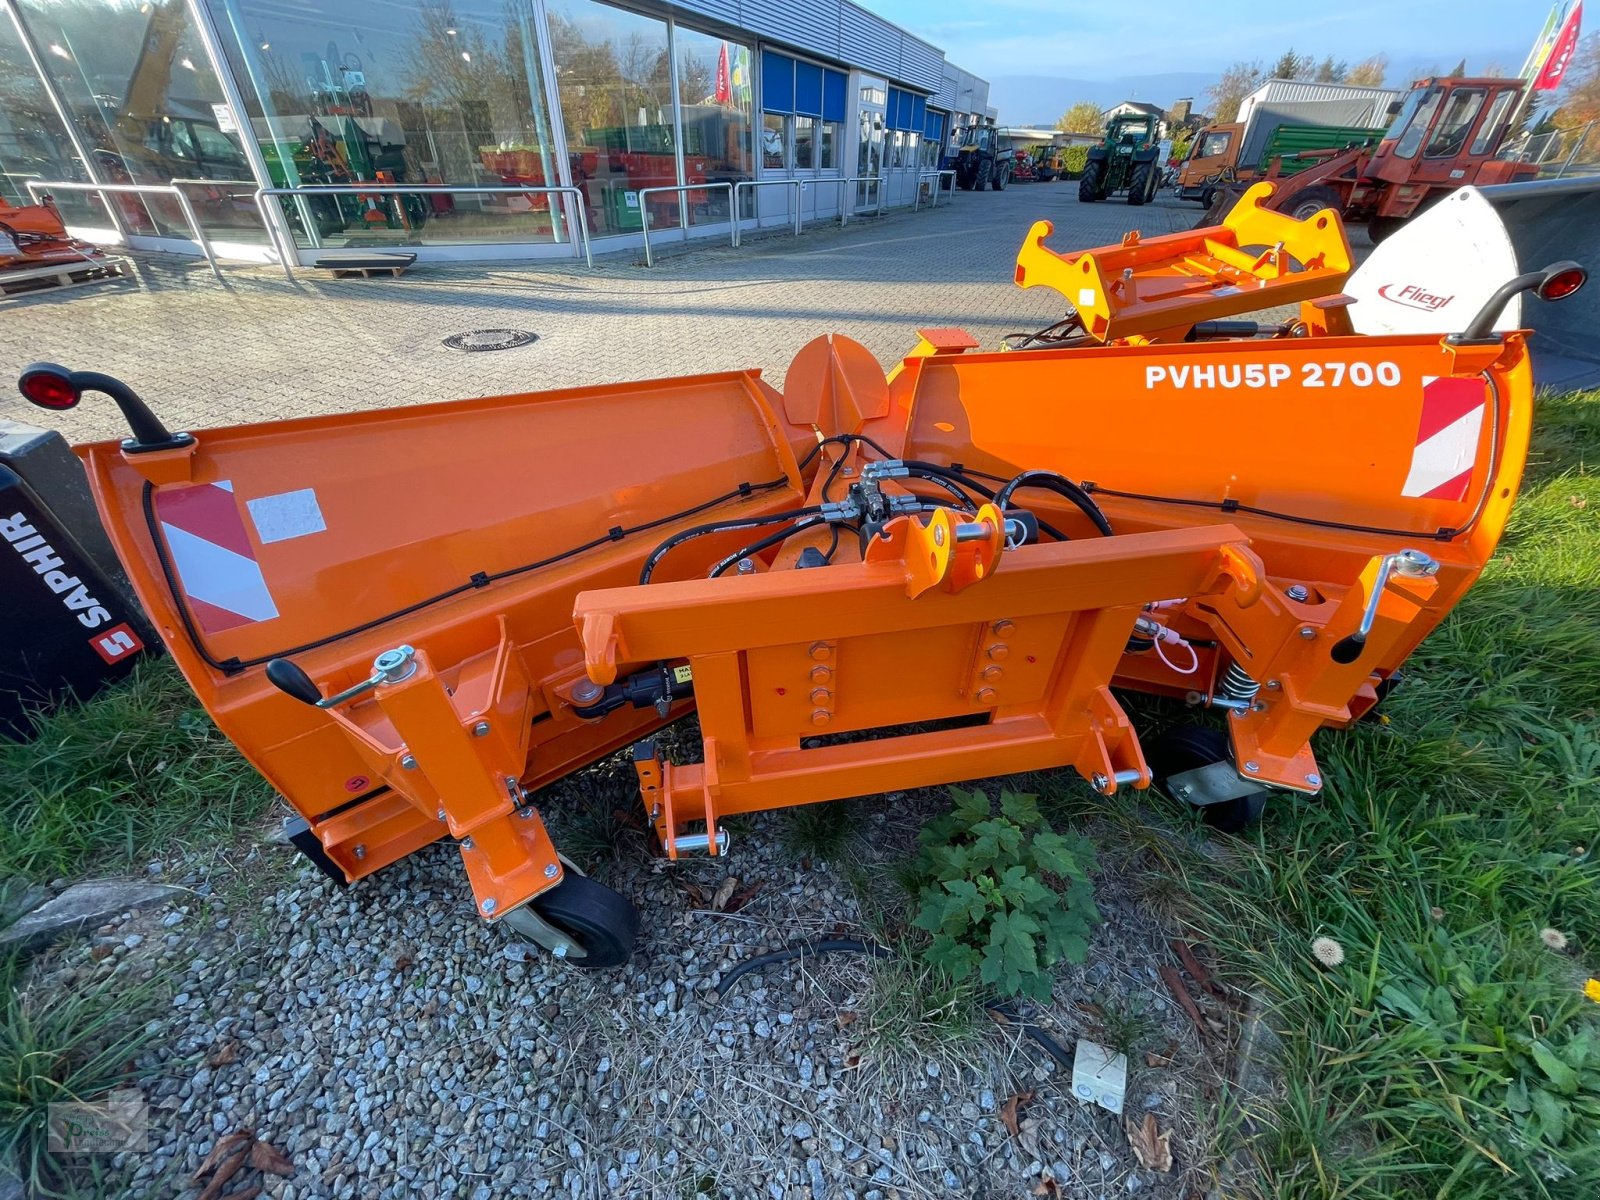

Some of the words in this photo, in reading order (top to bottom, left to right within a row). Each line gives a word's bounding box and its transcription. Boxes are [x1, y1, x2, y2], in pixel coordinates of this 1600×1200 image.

[1397, 284, 1455, 309] Fliegl
[1145, 364, 1291, 390] PVHU5P
[1301, 361, 1401, 388] 2700
[0, 511, 112, 628] SAPHIR
